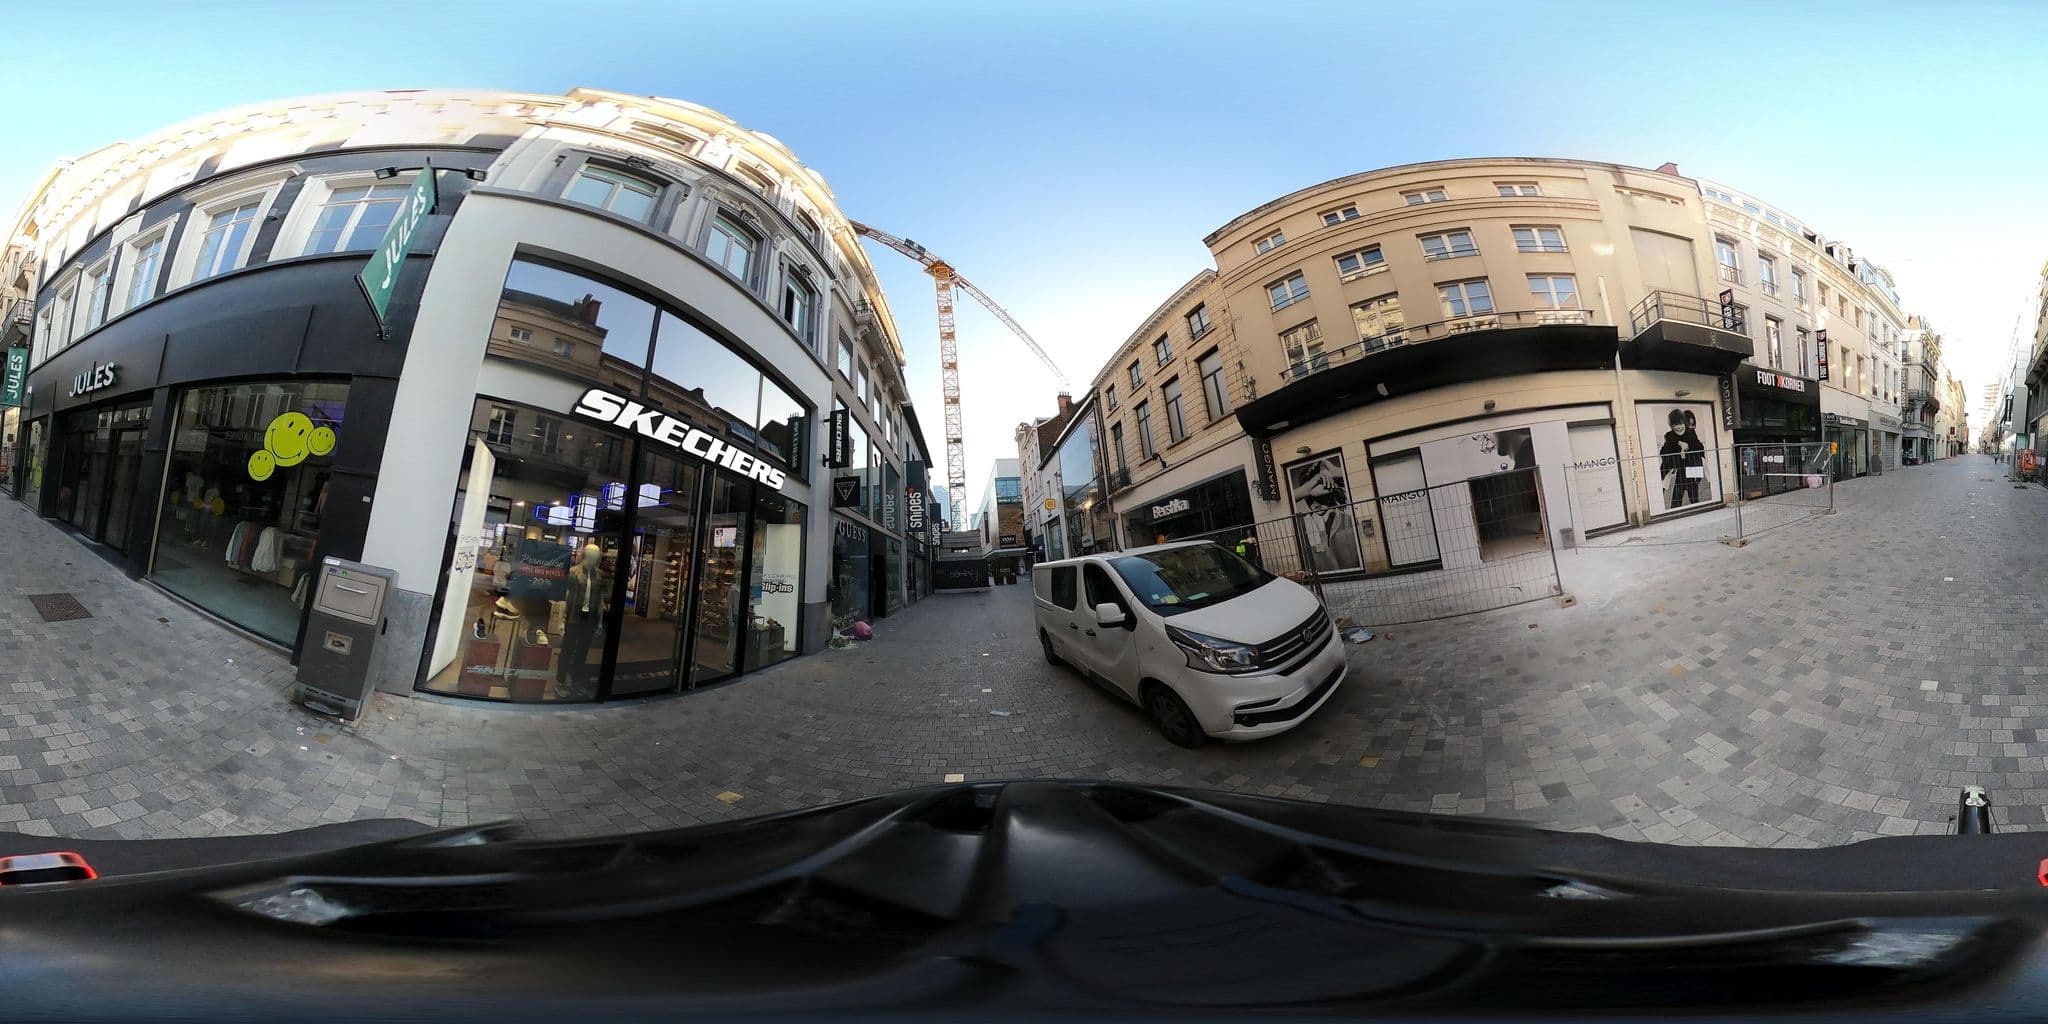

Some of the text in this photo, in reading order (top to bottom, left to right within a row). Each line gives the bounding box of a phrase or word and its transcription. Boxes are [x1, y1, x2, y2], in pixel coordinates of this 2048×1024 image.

[381, 186, 426, 289] JULES
[6, 355, 23, 399] JULES
[68, 361, 116, 398] JULES
[1756, 370, 1776, 387] FOOT
[574, 388, 786, 491] SKECHERS
[1262, 443, 1277, 495] MANGO
[1574, 457, 1616, 471] MANGO
[909, 492, 925, 528] snipes
[1151, 498, 1191, 519] Bershka
[1381, 488, 1426, 505] MANGO
[838, 519, 867, 543] GUESS
[932, 522, 942, 546] snipes
